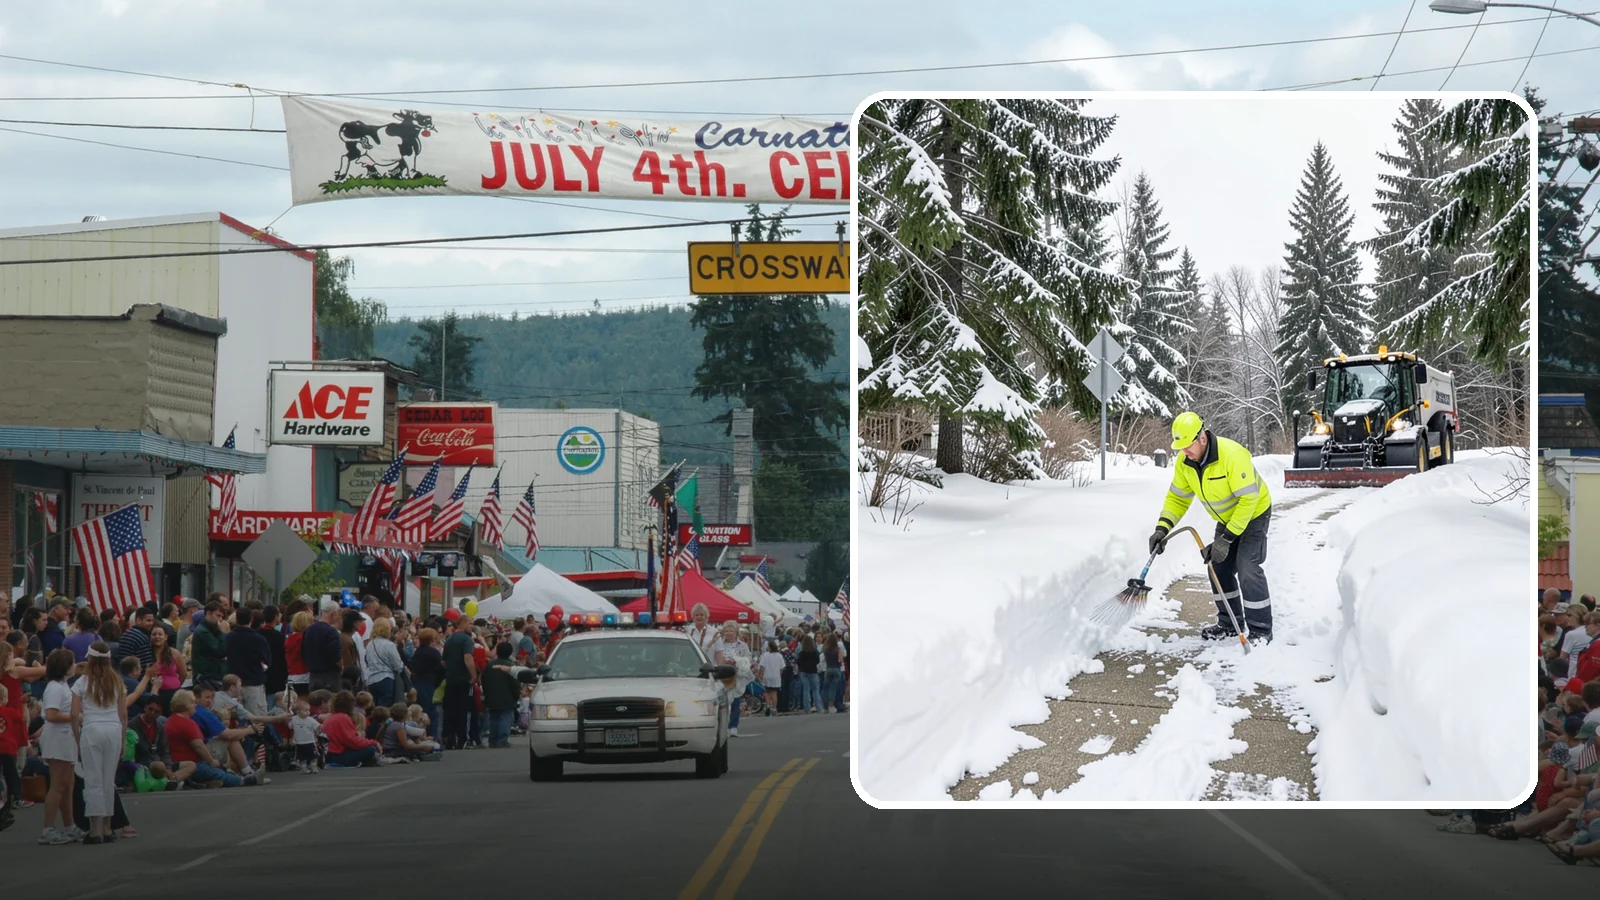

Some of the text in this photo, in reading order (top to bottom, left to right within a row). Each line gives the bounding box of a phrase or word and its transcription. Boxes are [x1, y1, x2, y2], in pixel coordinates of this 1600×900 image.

[481, 141, 604, 192] JULY
[632, 150, 746, 197] 4th.
[697, 254, 850, 280] CROSSWA
[283, 380, 373, 420] ACE
[406, 409, 485, 422] CEDAR LOG
[284, 421, 370, 436] Hardware
[417, 428, 477, 447] Coca-Cola
[83, 485, 155, 495] St. Vincent de Paul
[688, 526, 741, 535] CRNATION
[699, 535, 730, 543] GLASS
